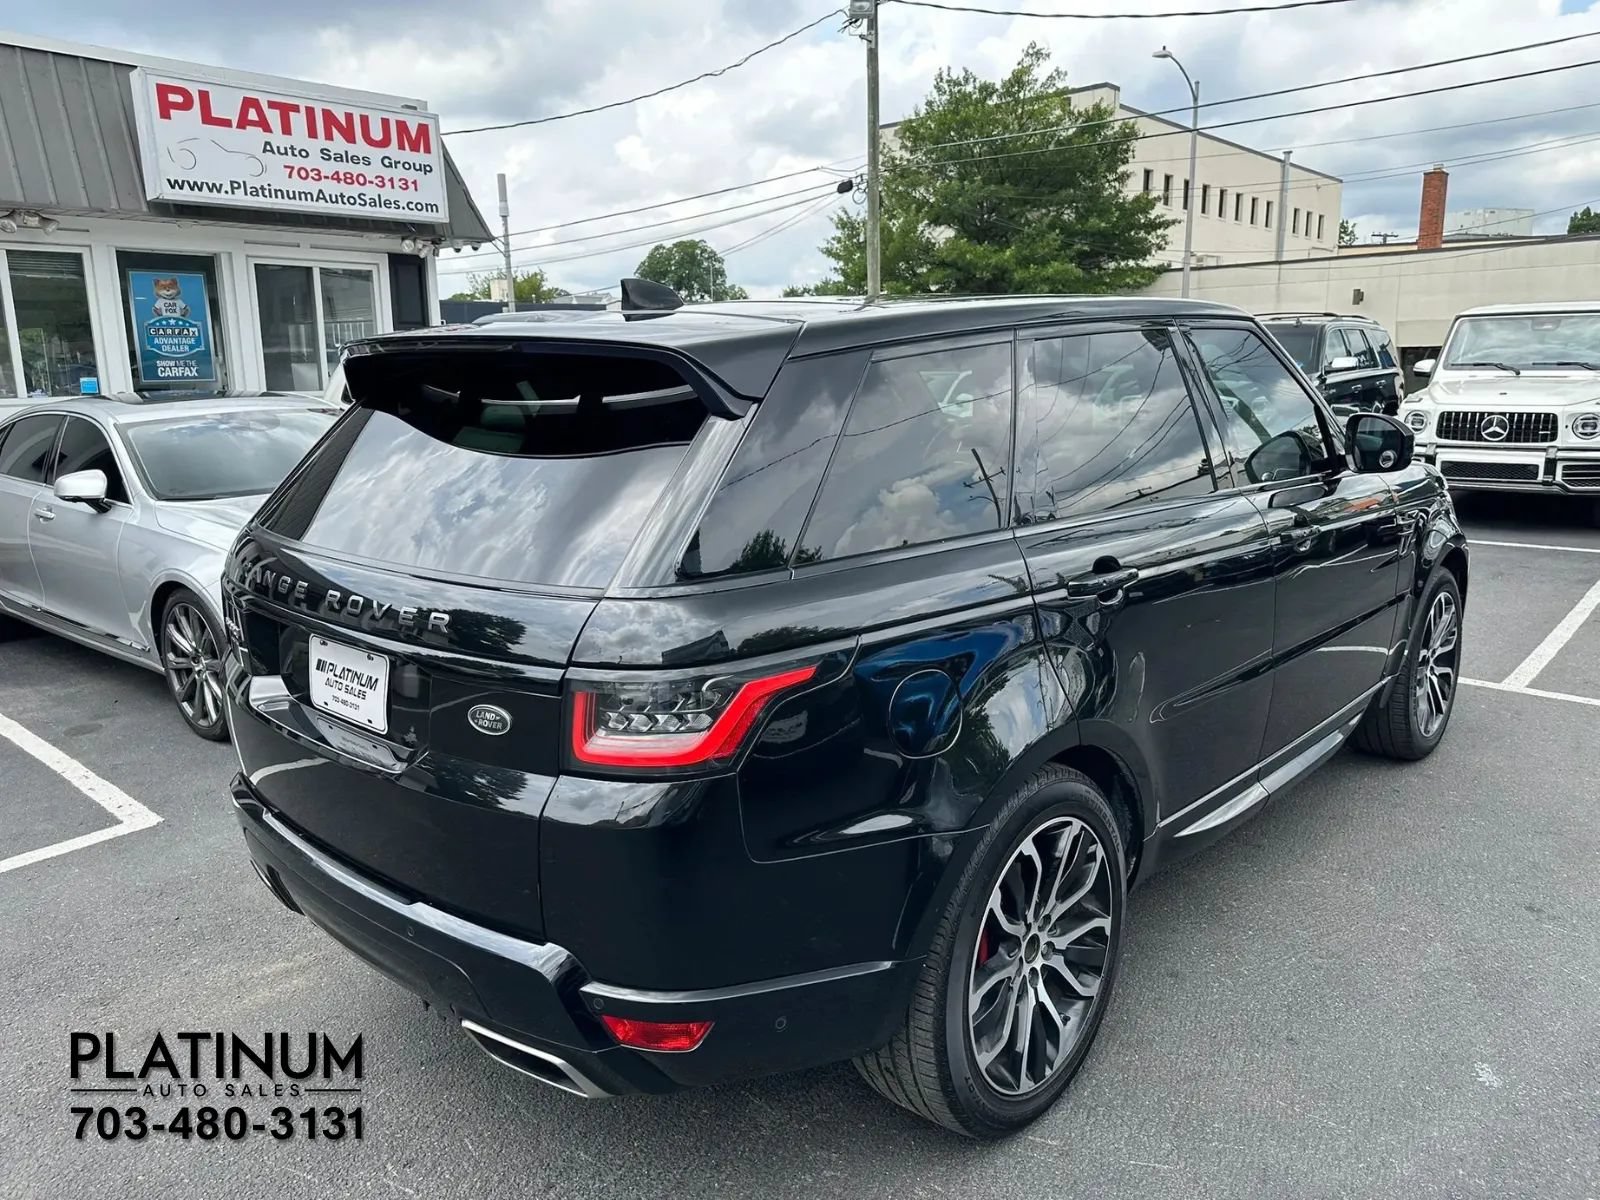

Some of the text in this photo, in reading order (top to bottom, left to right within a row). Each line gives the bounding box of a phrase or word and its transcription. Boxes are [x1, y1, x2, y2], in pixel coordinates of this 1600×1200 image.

[155, 83, 432, 154] PLATINUM
[262, 140, 433, 175] Auto Sales Group
[283, 165, 419, 192] 703-480-3131
[167, 177, 439, 213] www.PlatinumAutoSales.com
[149, 328, 198, 336] CARFAX
[154, 337, 196, 345] ADVANTAGE
[157, 366, 198, 377] CARFAX
[325, 589, 450, 634] ROVER
[324, 677, 367, 700] AUTO SALES
[326, 661, 379, 692] PLATINUM
[475, 710, 496, 721] LAND
[477, 718, 503, 730] ROVER
